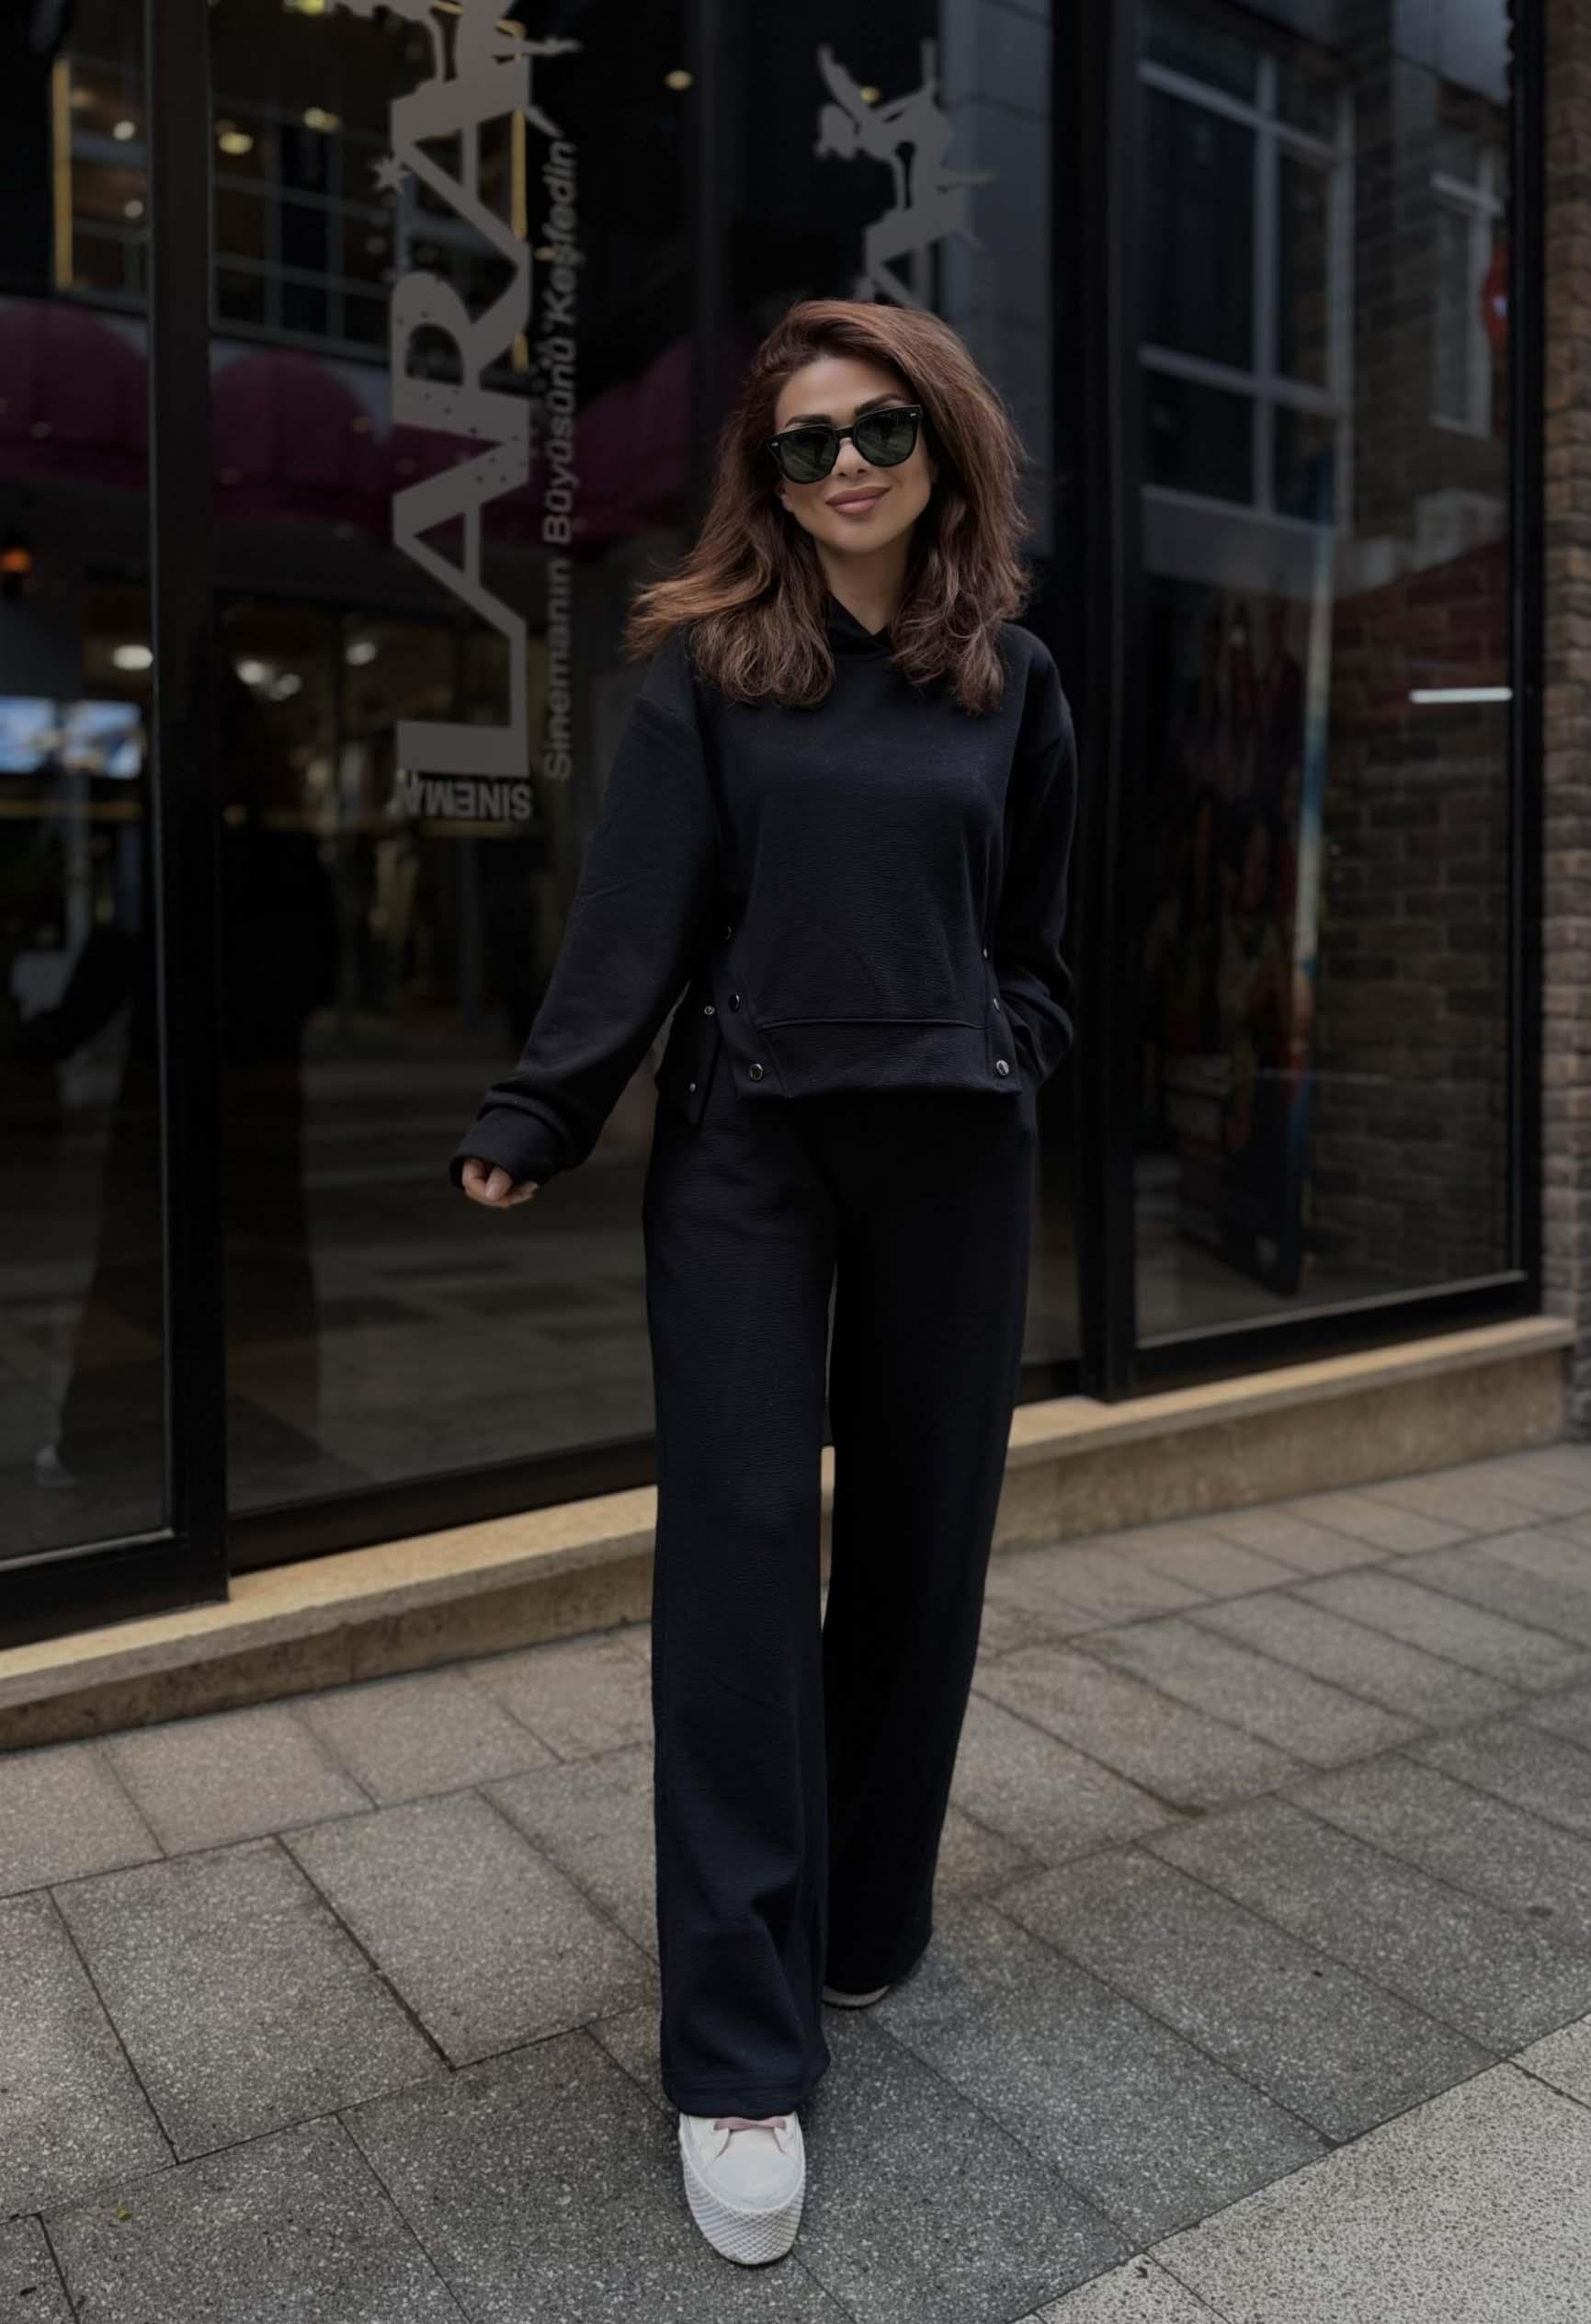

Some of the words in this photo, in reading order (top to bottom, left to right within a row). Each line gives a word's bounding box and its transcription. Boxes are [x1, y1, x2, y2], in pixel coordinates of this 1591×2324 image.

[540, 140, 584, 325] Keşfedin
[392, 60, 530, 776] LARA
[540, 335, 579, 544] Büyüsünü
[544, 557, 574, 780] Sinemanın
[397, 779, 533, 820] SINEMA
